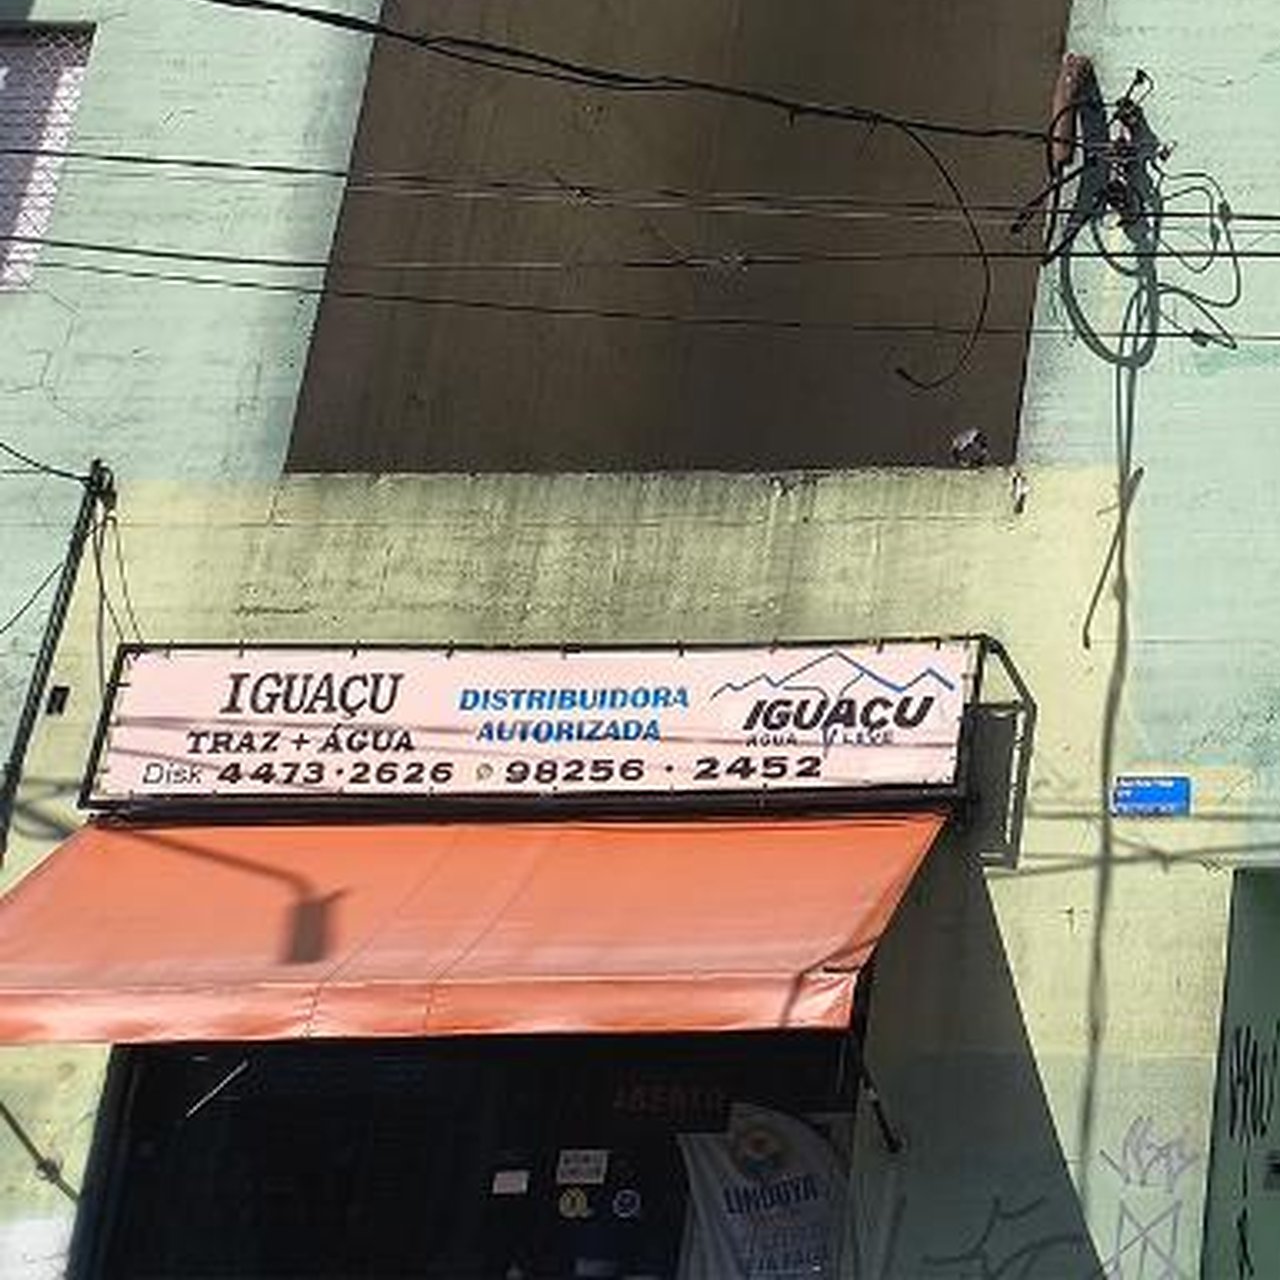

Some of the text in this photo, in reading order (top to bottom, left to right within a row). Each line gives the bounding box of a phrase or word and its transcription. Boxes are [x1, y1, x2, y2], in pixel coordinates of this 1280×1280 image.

[220, 672, 405, 720] IGUAÇU
[458, 686, 690, 711] DISTRIBUIDORA
[186, 730, 281, 755] TRAZ
[318, 724, 417, 753] ÁGUA
[475, 720, 661, 744] AUTORIZADA
[142, 763, 205, 785] Disk
